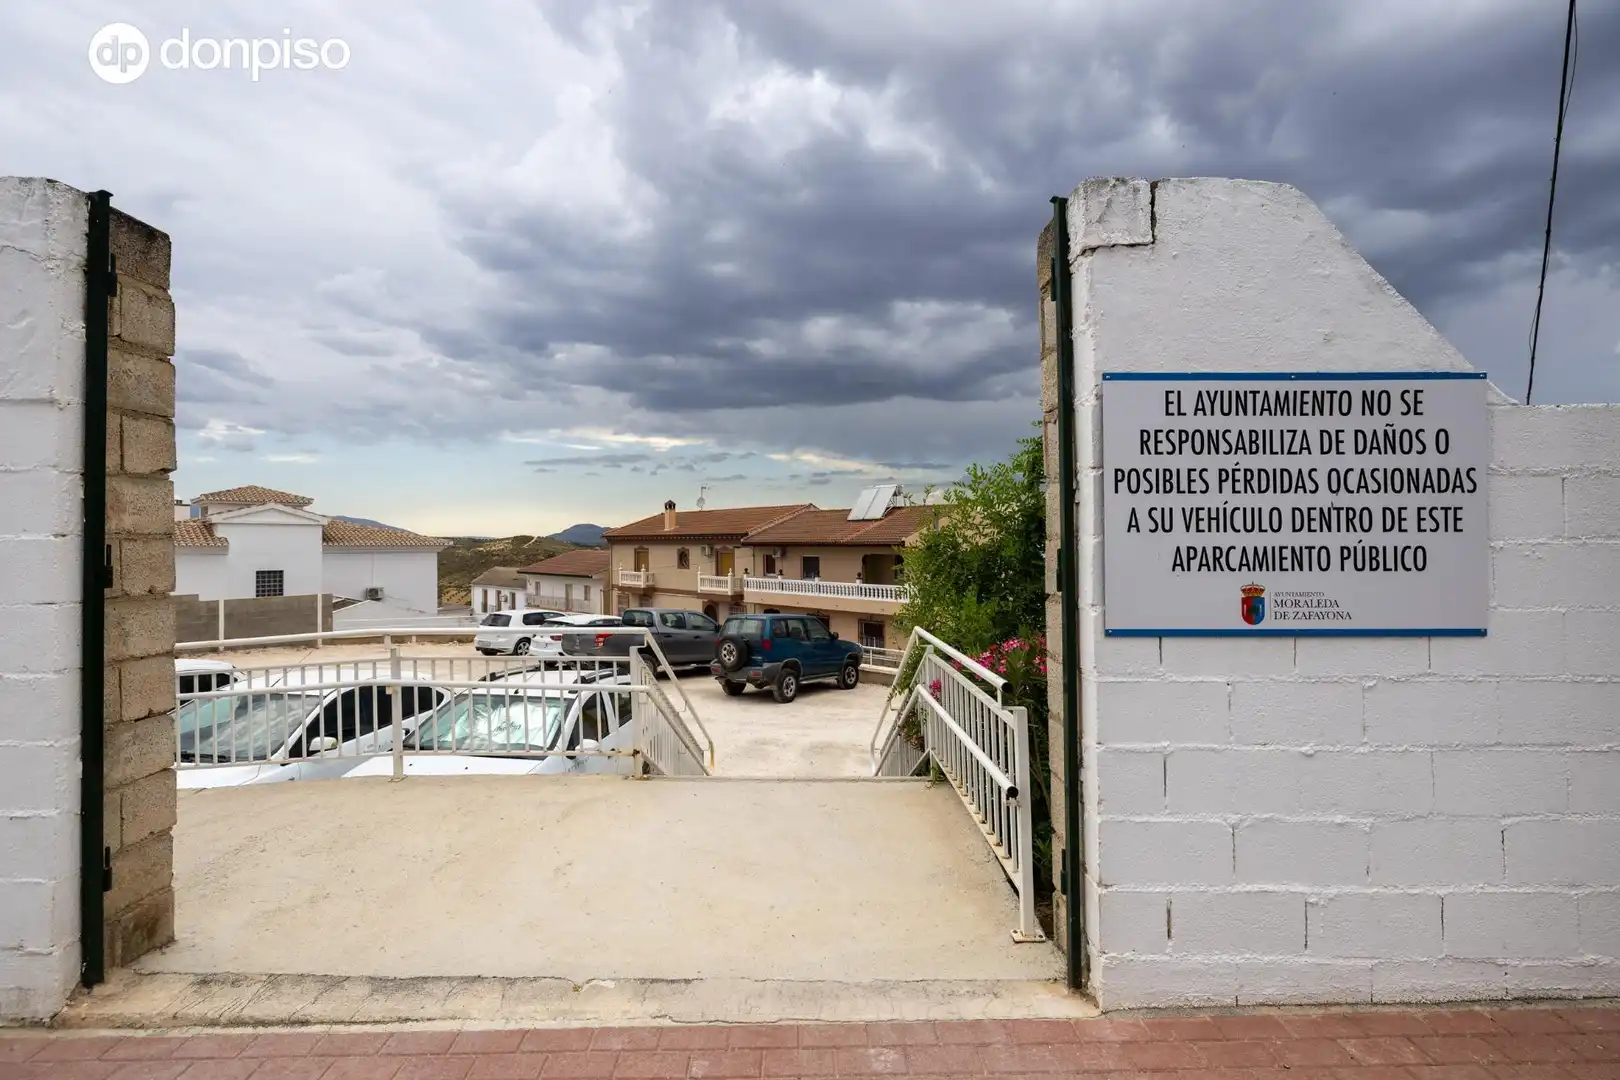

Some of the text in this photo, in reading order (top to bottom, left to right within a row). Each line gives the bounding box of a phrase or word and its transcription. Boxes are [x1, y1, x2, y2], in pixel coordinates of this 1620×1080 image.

[1164, 389, 1424, 417] EL AYUNTAMIENTO NO SE
[1139, 422, 1450, 456] RESPONSABILIZA DE DAÑOS O
[1114, 461, 1478, 496] POSIBLES PÉRDIDAS OCASIONADAS
[1126, 500, 1464, 534] A SU VEHÍCULO DENTRO DE ESTE
[1171, 539, 1427, 573] APARCAMIENTO PÚBLICO
[1273, 599, 1340, 609] MORALEDA
[1273, 610, 1352, 621] DE ZAFAYONA
